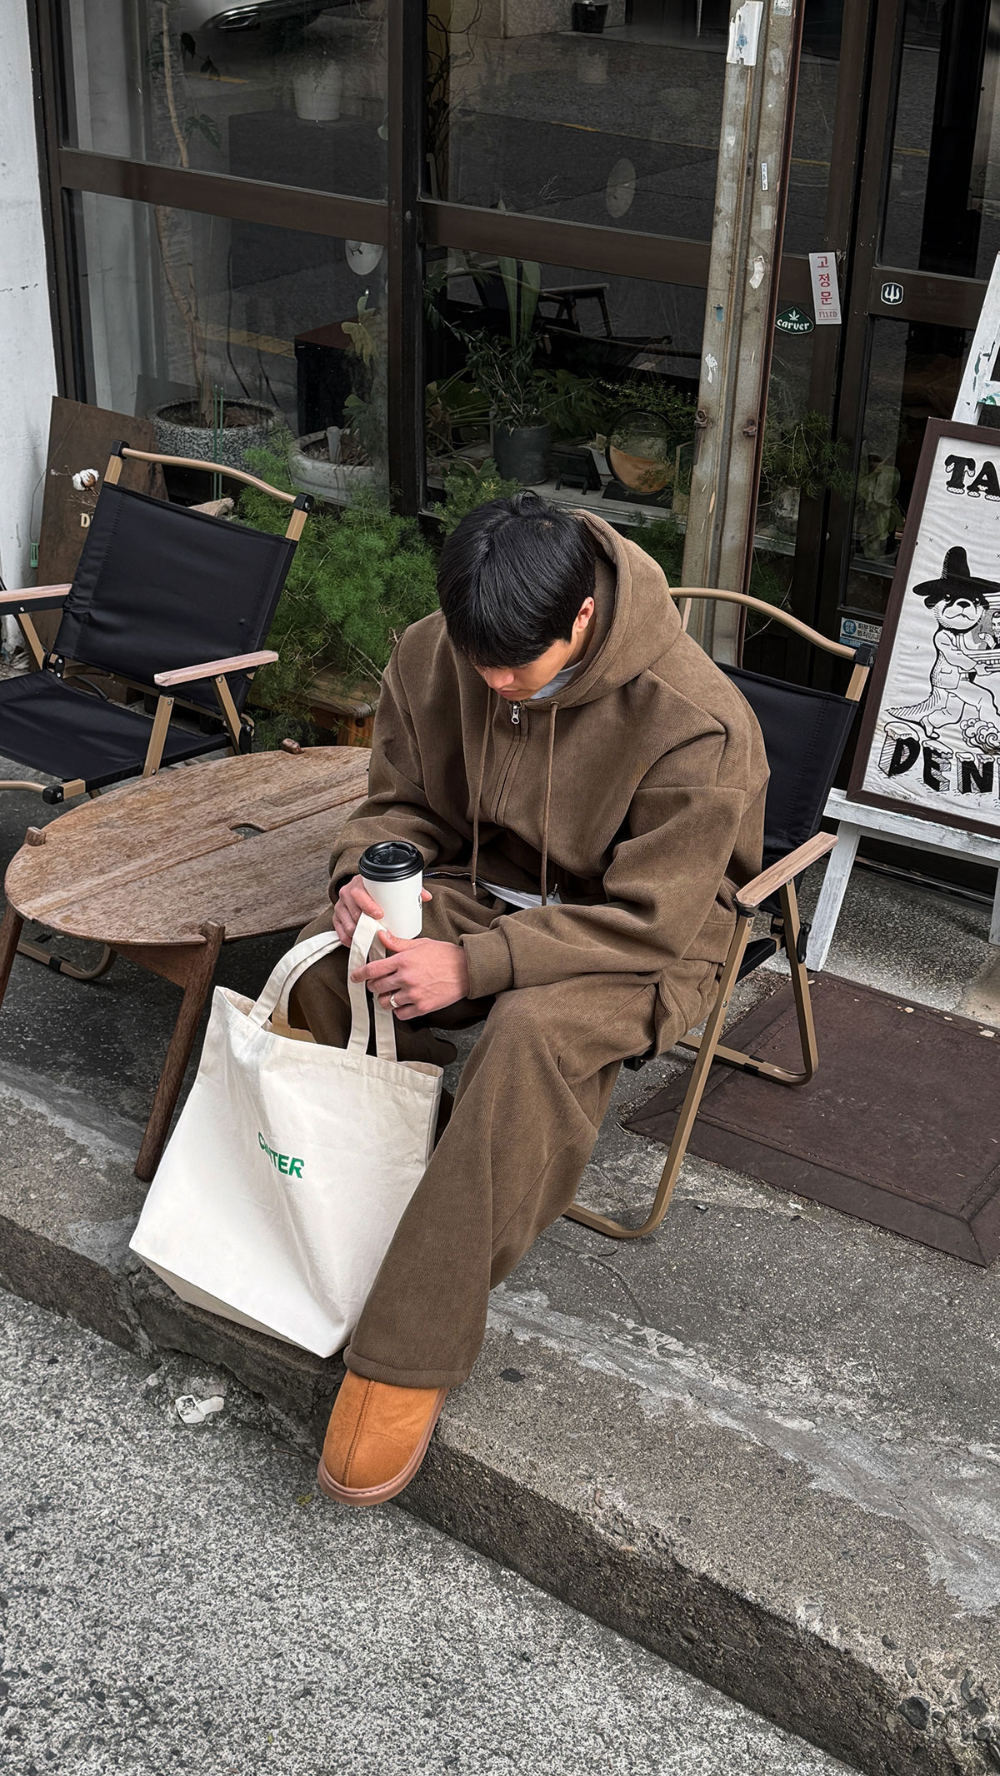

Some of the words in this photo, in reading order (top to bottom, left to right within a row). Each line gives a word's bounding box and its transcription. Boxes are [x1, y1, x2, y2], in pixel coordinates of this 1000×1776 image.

[816, 255, 833, 306] 고정문
[776, 318, 811, 331] carver
[80, 513, 94, 528] D
[877, 721, 1000, 800] DEN
[257, 1131, 305, 1179] CTER
